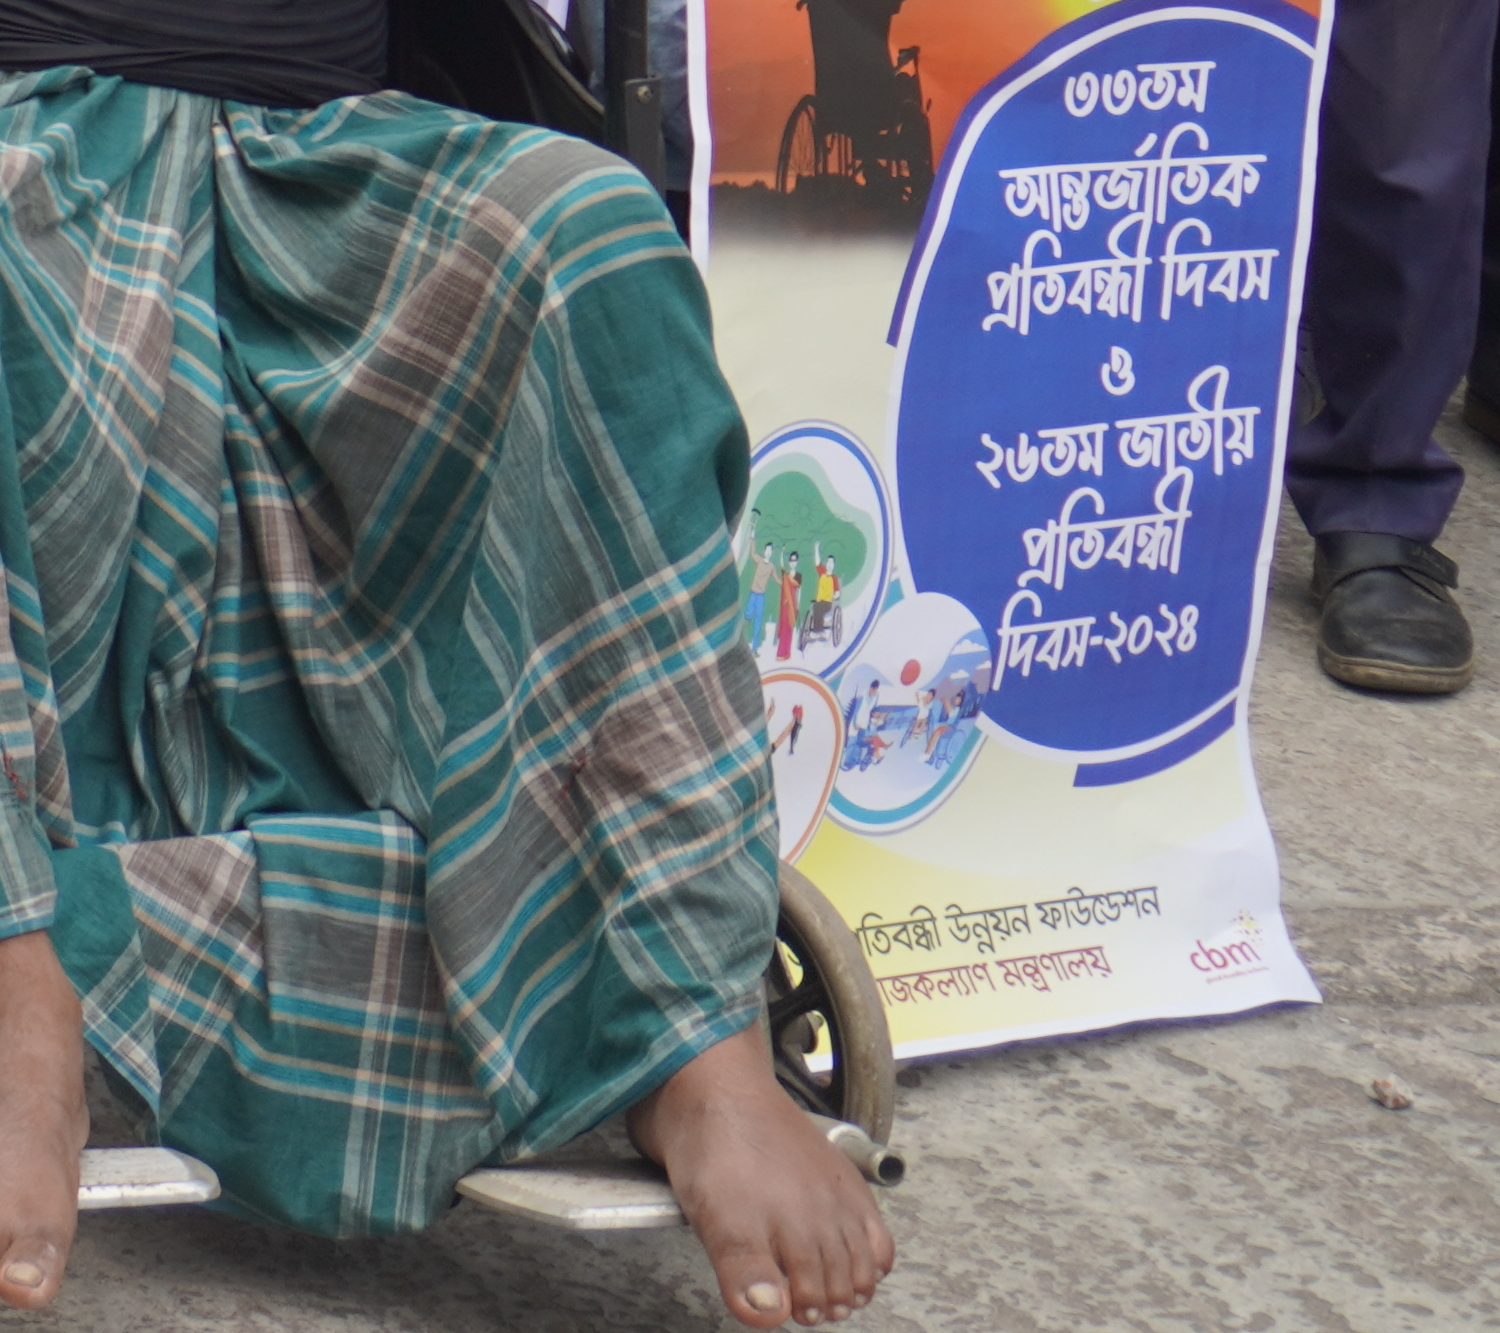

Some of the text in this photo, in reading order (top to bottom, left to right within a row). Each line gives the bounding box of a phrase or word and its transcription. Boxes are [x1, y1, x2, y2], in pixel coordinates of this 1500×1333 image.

[1064, 60, 1216, 117] ৩৩তম
[999, 121, 1267, 233] আন্তর্জাতিক
[982, 211, 1279, 336] প্রতিবন্ধী দিবস
[1101, 345, 1135, 396] ও
[975, 365, 1261, 489] ২৬তম জাতীয়
[1017, 465, 1194, 591] প্রতিবন্ধী
[992, 588, 1200, 691] দিবস-২০২৪
[945, 904, 1031, 954] উন্নয়ন
[995, 946, 1113, 992] মন্ত্রণালয়
[1190, 939, 1261, 971] cbm
